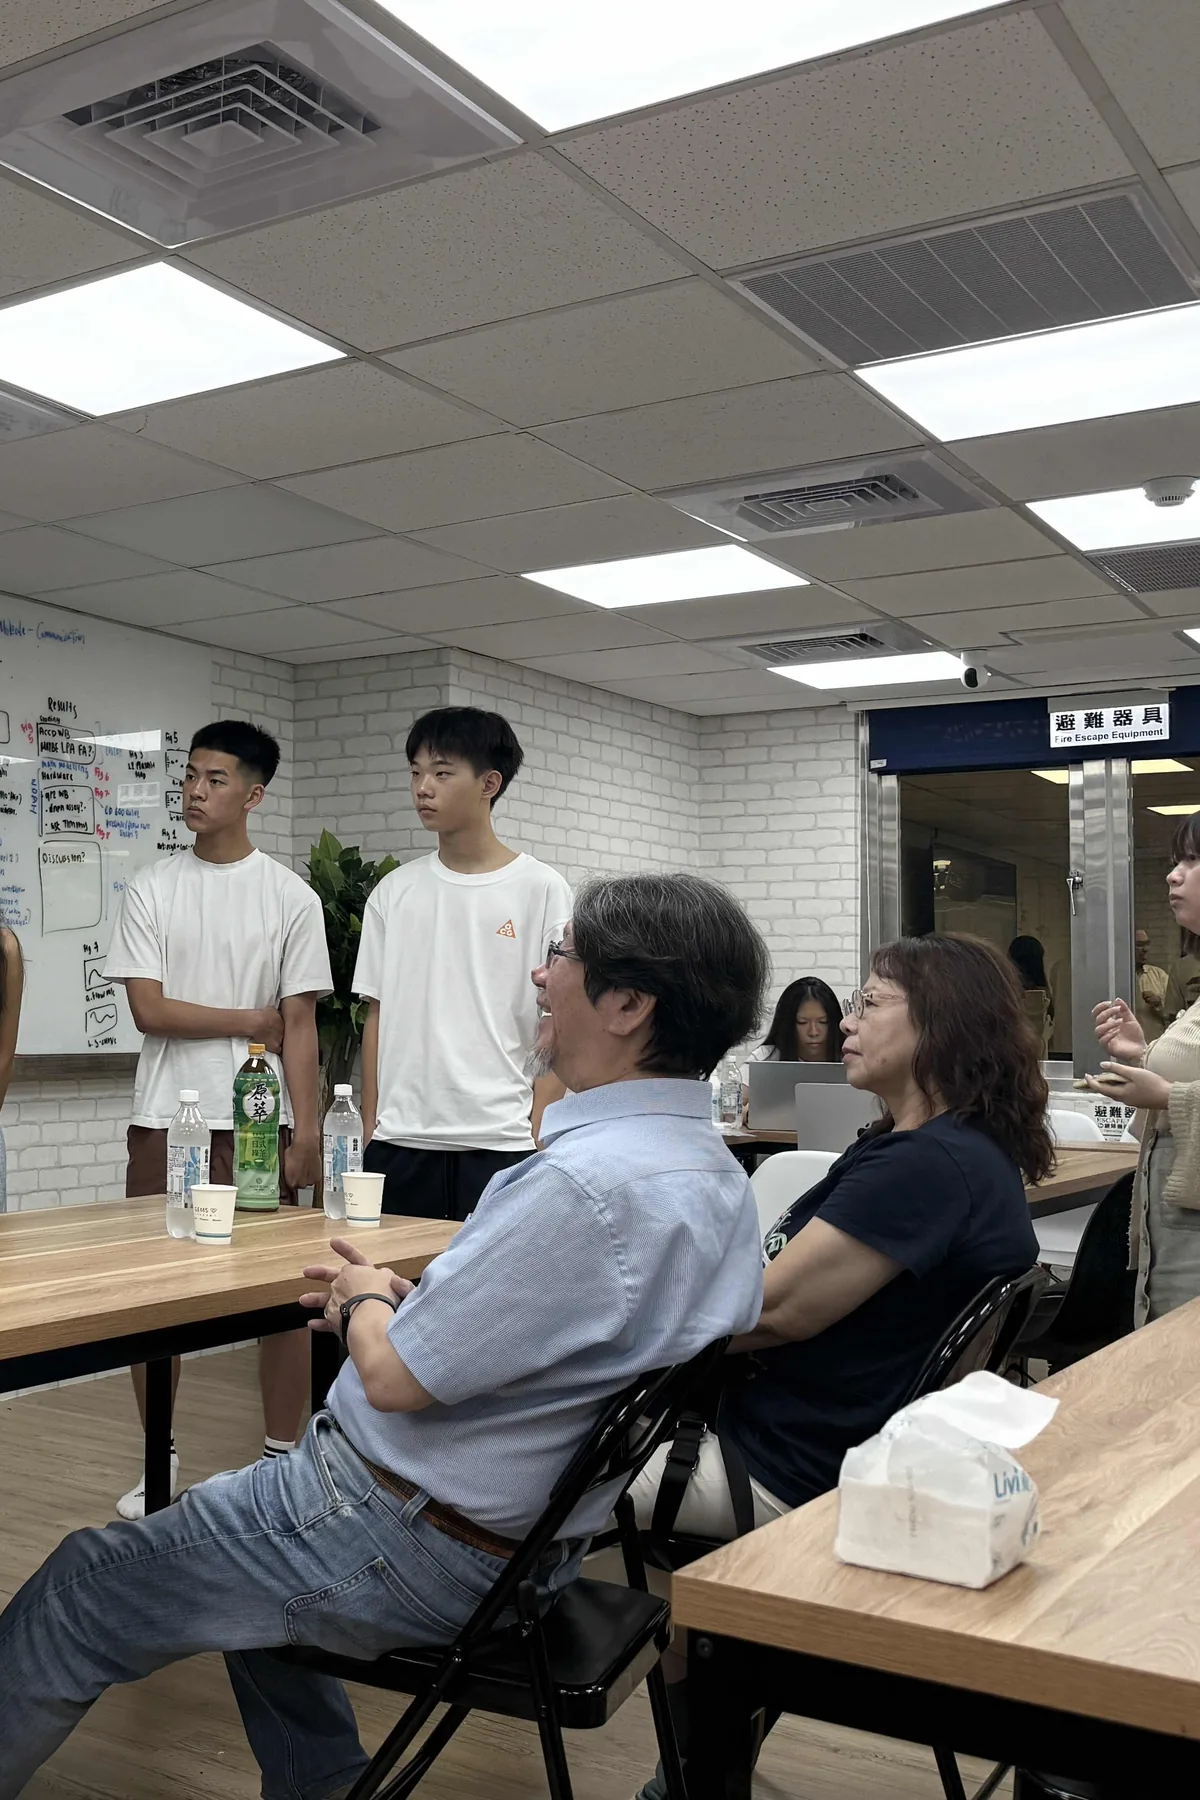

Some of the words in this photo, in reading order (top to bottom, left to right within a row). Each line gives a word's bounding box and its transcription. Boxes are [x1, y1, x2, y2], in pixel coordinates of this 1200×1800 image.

[48, 697, 77, 719] Results
[1056, 706, 1163, 732] 避難器具
[1055, 735, 1072, 743] Fire
[1075, 732, 1109, 742] Escape
[1111, 728, 1163, 740] Equipment
[41, 771, 73, 781] Hardware
[42, 852, 85, 864] Discussion?
[248, 1083, 268, 1123] 原萃
